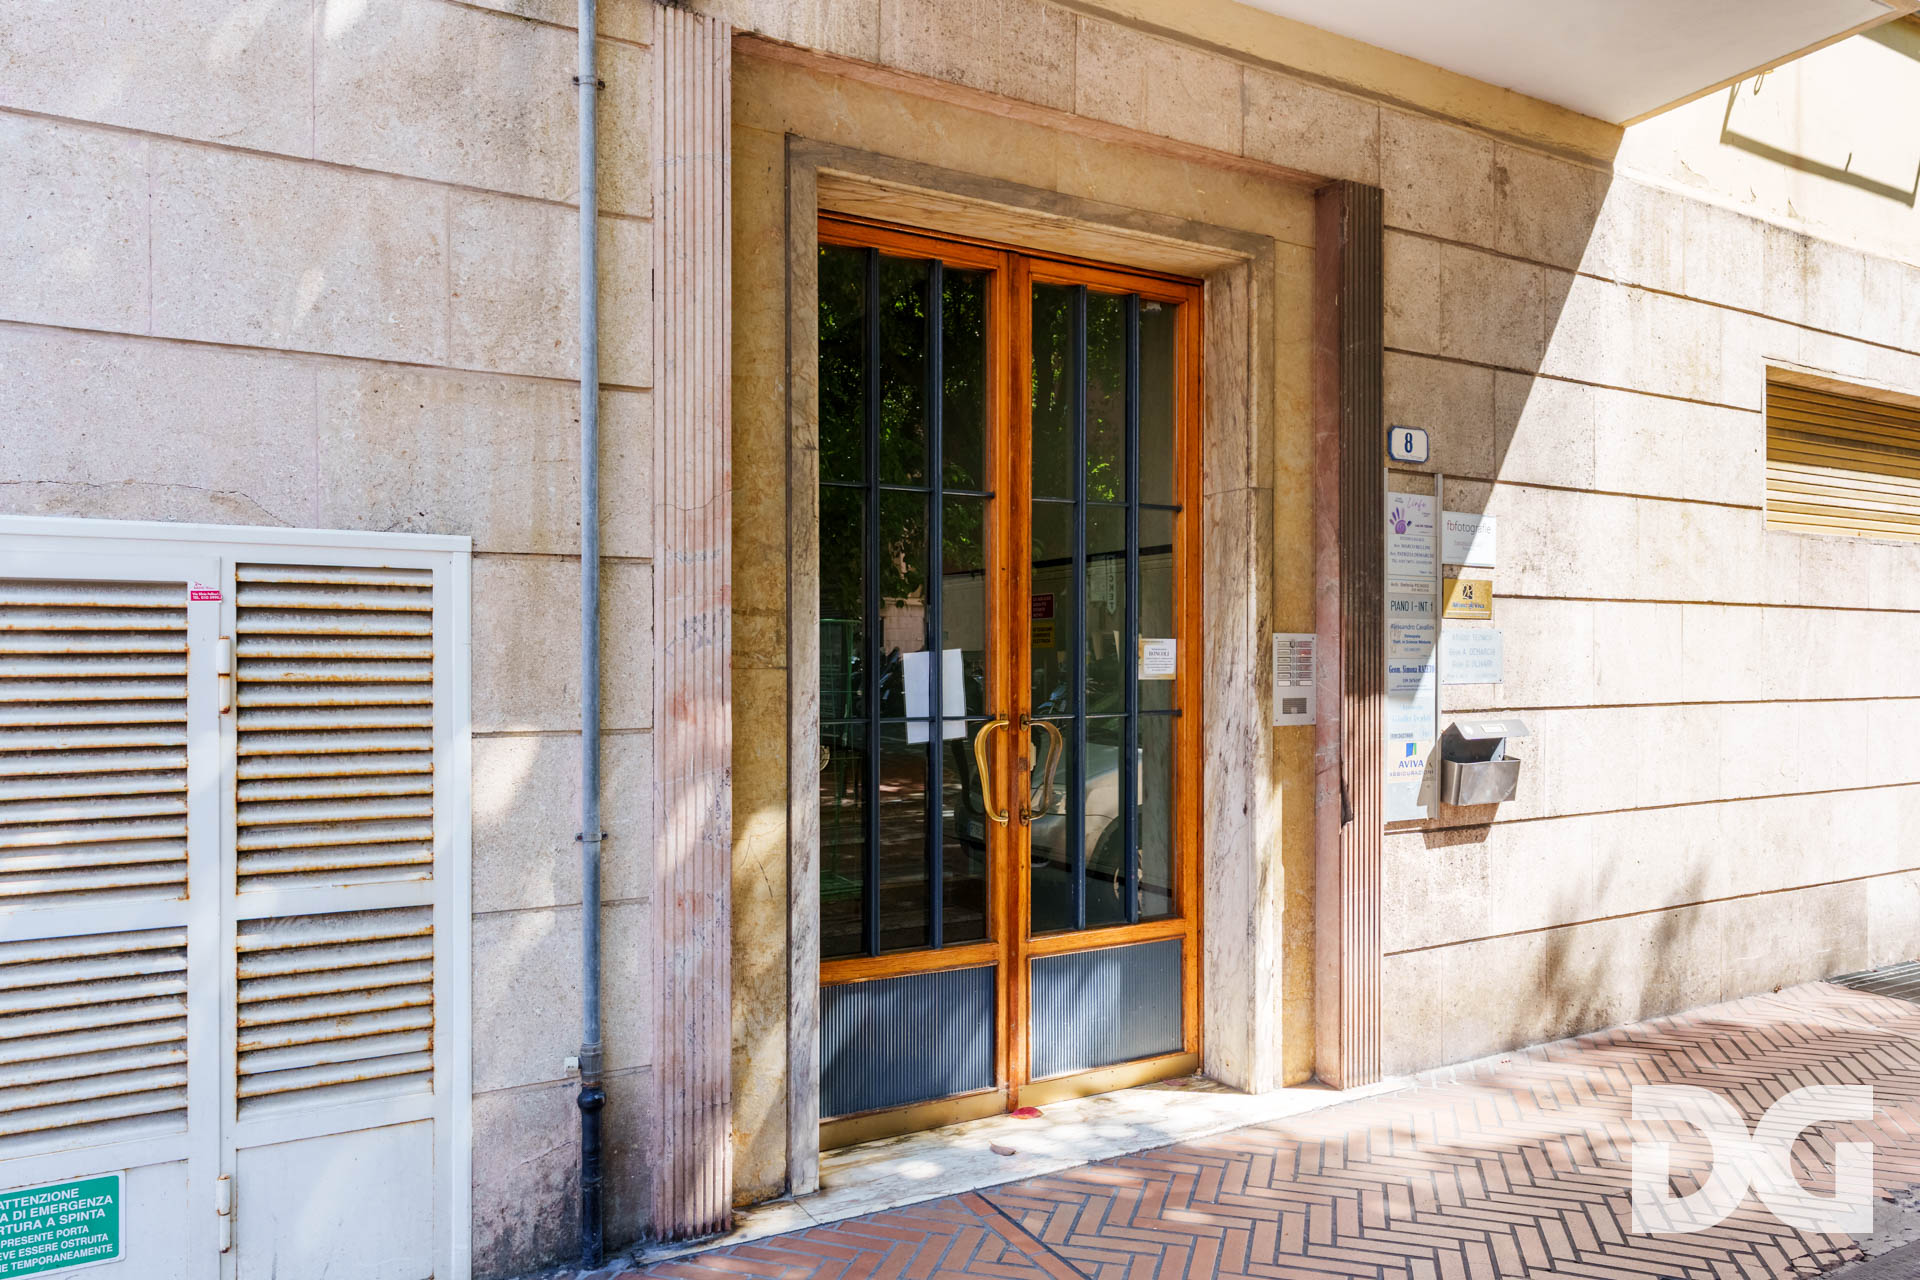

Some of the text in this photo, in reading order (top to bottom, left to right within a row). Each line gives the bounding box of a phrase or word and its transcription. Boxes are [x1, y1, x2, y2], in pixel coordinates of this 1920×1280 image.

[1404, 432, 1413, 453] 8
[1447, 520, 1491, 535] fbfotografie
[1390, 600, 1409, 611] PIANO
[1398, 759, 1424, 769] AVIVA
[13, 1210, 26, 1221] DI
[30, 1195, 113, 1218] EMERGENZA
[46, 1217, 56, 1228] A
[59, 1208, 106, 1225] SPINTA
[0, 1225, 89, 1249] PRESENTE PORTA
[18, 1242, 59, 1258] ESSERE
[60, 1233, 109, 1249] OSTRUITA
[10, 1244, 113, 1270] TEMPORANEAMENTE
